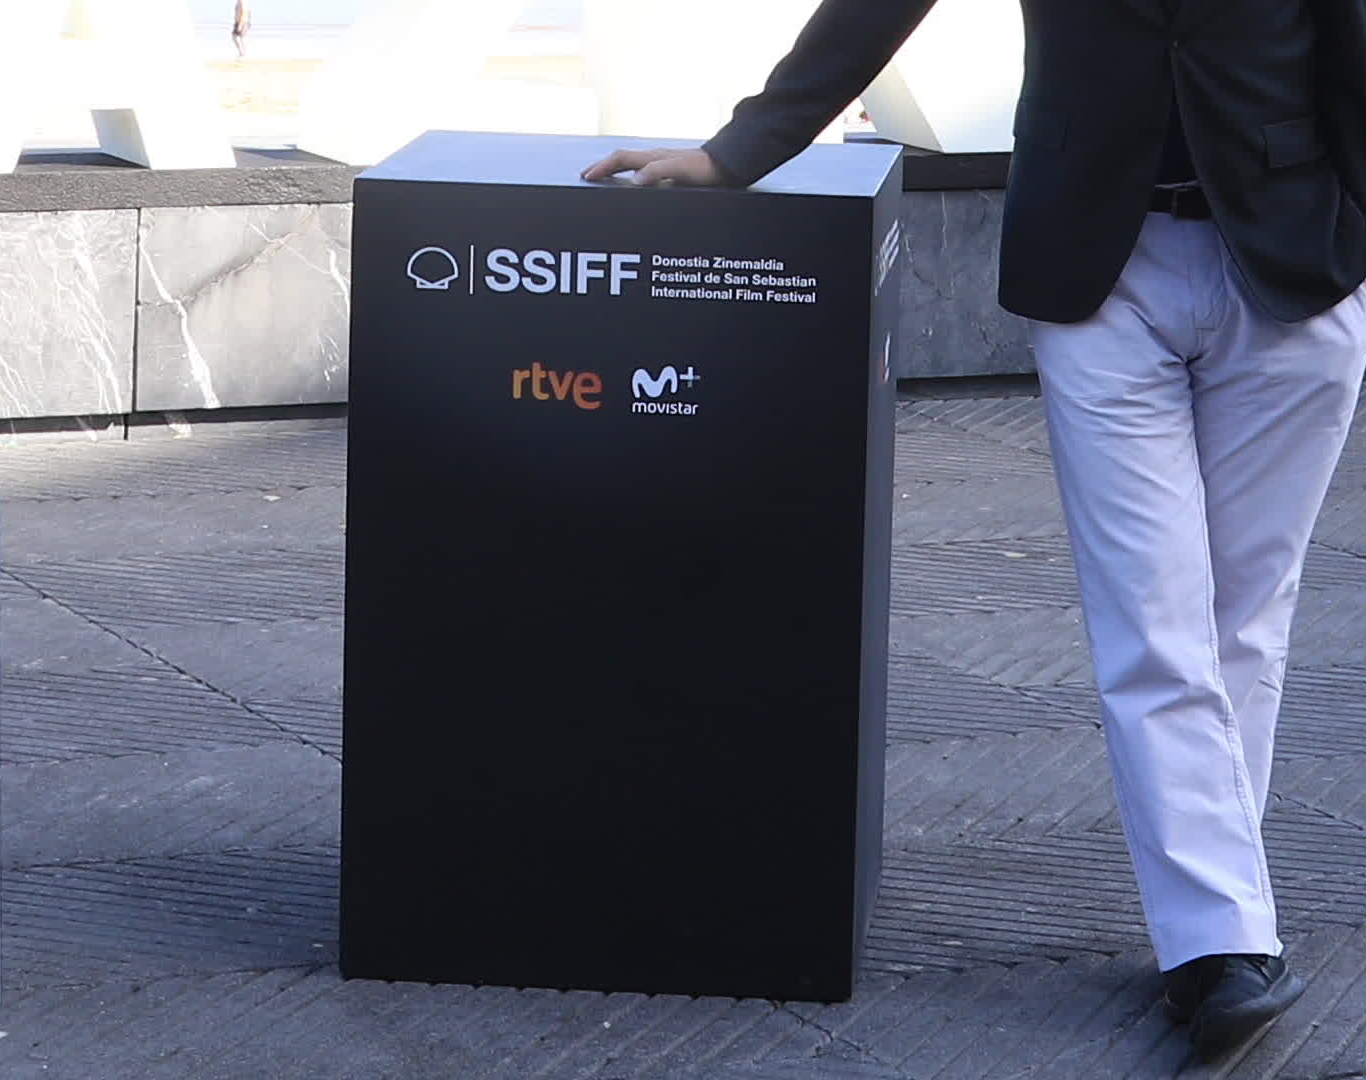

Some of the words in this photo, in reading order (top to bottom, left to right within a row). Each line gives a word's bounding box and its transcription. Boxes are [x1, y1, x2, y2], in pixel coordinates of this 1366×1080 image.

[651, 255, 710, 268] Donostia
[712, 257, 784, 271] Zinemaldia
[484, 248, 641, 296] SSIFF
[651, 271, 701, 283] Festival
[704, 272, 720, 284] de
[723, 273, 749, 285] San
[651, 286, 732, 300] International
[735, 289, 763, 301] Film
[766, 290, 816, 303] Festival
[512, 362, 603, 410] rtve
[632, 401, 699, 415] movistar
